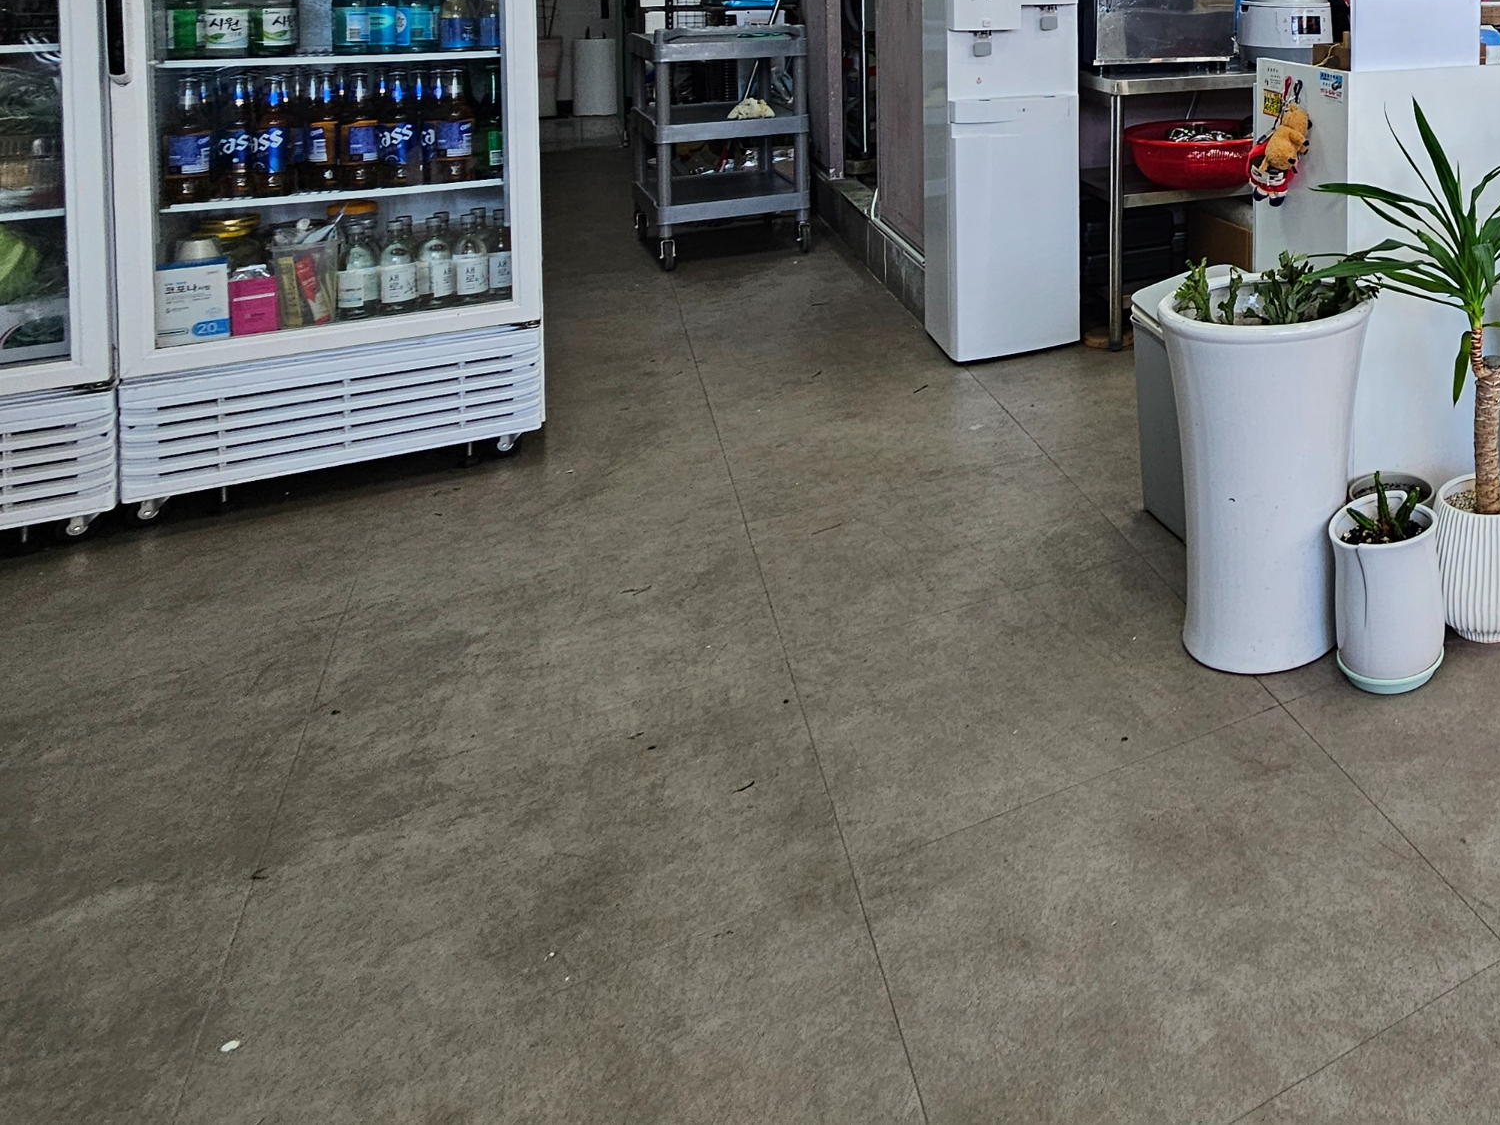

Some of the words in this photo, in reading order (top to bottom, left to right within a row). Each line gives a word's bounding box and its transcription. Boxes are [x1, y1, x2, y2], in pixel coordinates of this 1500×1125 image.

[209, 17, 242, 31] 시원
[250, 129, 284, 154] ass
[379, 124, 413, 148] ass
[197, 322, 218, 335] 20
